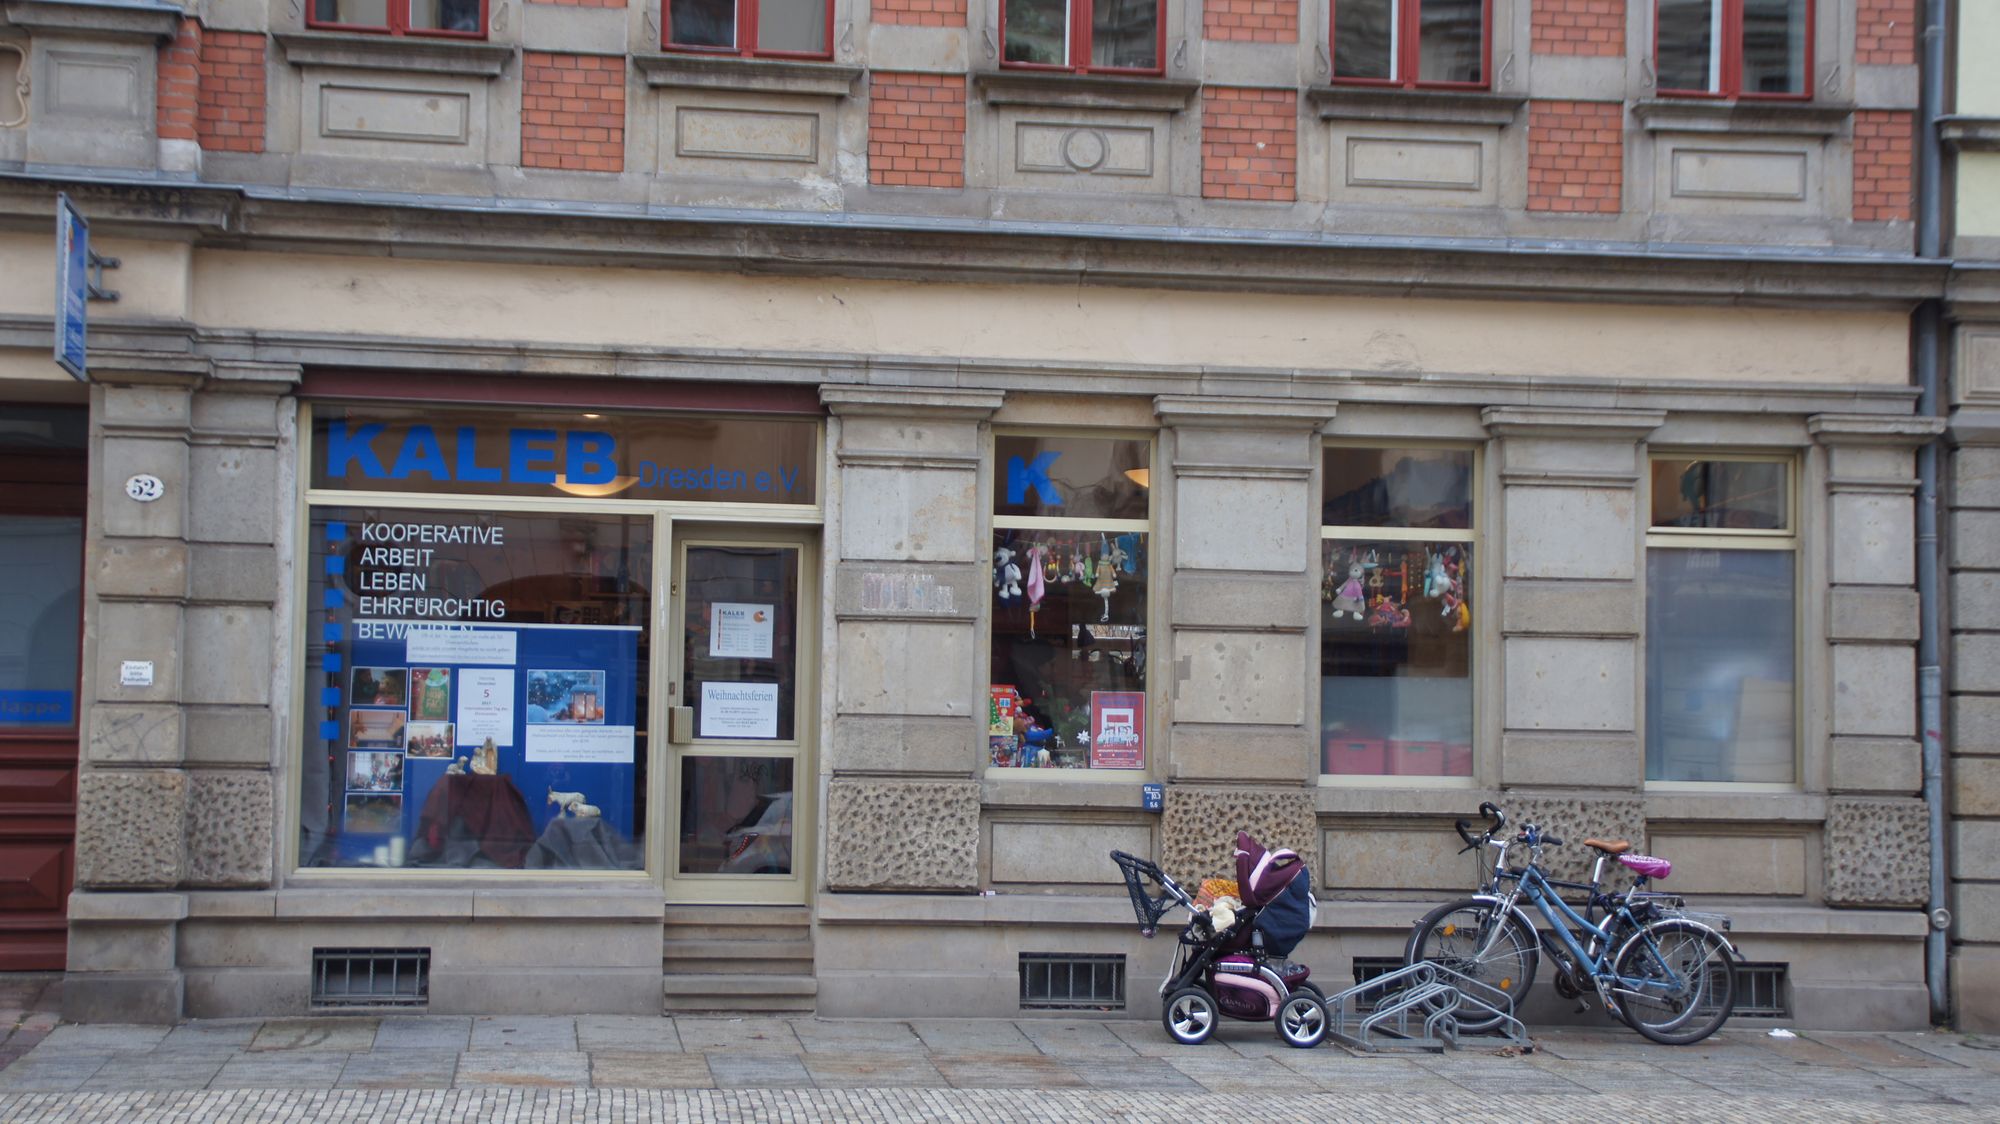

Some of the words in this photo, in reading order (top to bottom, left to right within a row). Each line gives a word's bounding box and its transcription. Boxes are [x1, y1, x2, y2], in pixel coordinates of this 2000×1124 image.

[327, 422, 618, 485] KALEB
[638, 459, 747, 491] Dresden
[131, 478, 155, 497] 52
[1007, 450, 1064, 506] K
[361, 522, 504, 545] KOOPERATIVE
[360, 547, 434, 567] ARBEIT
[360, 571, 426, 591] LEBEN
[483, 688, 490, 698] 5
[707, 688, 774, 702] Weihnachtsferien
